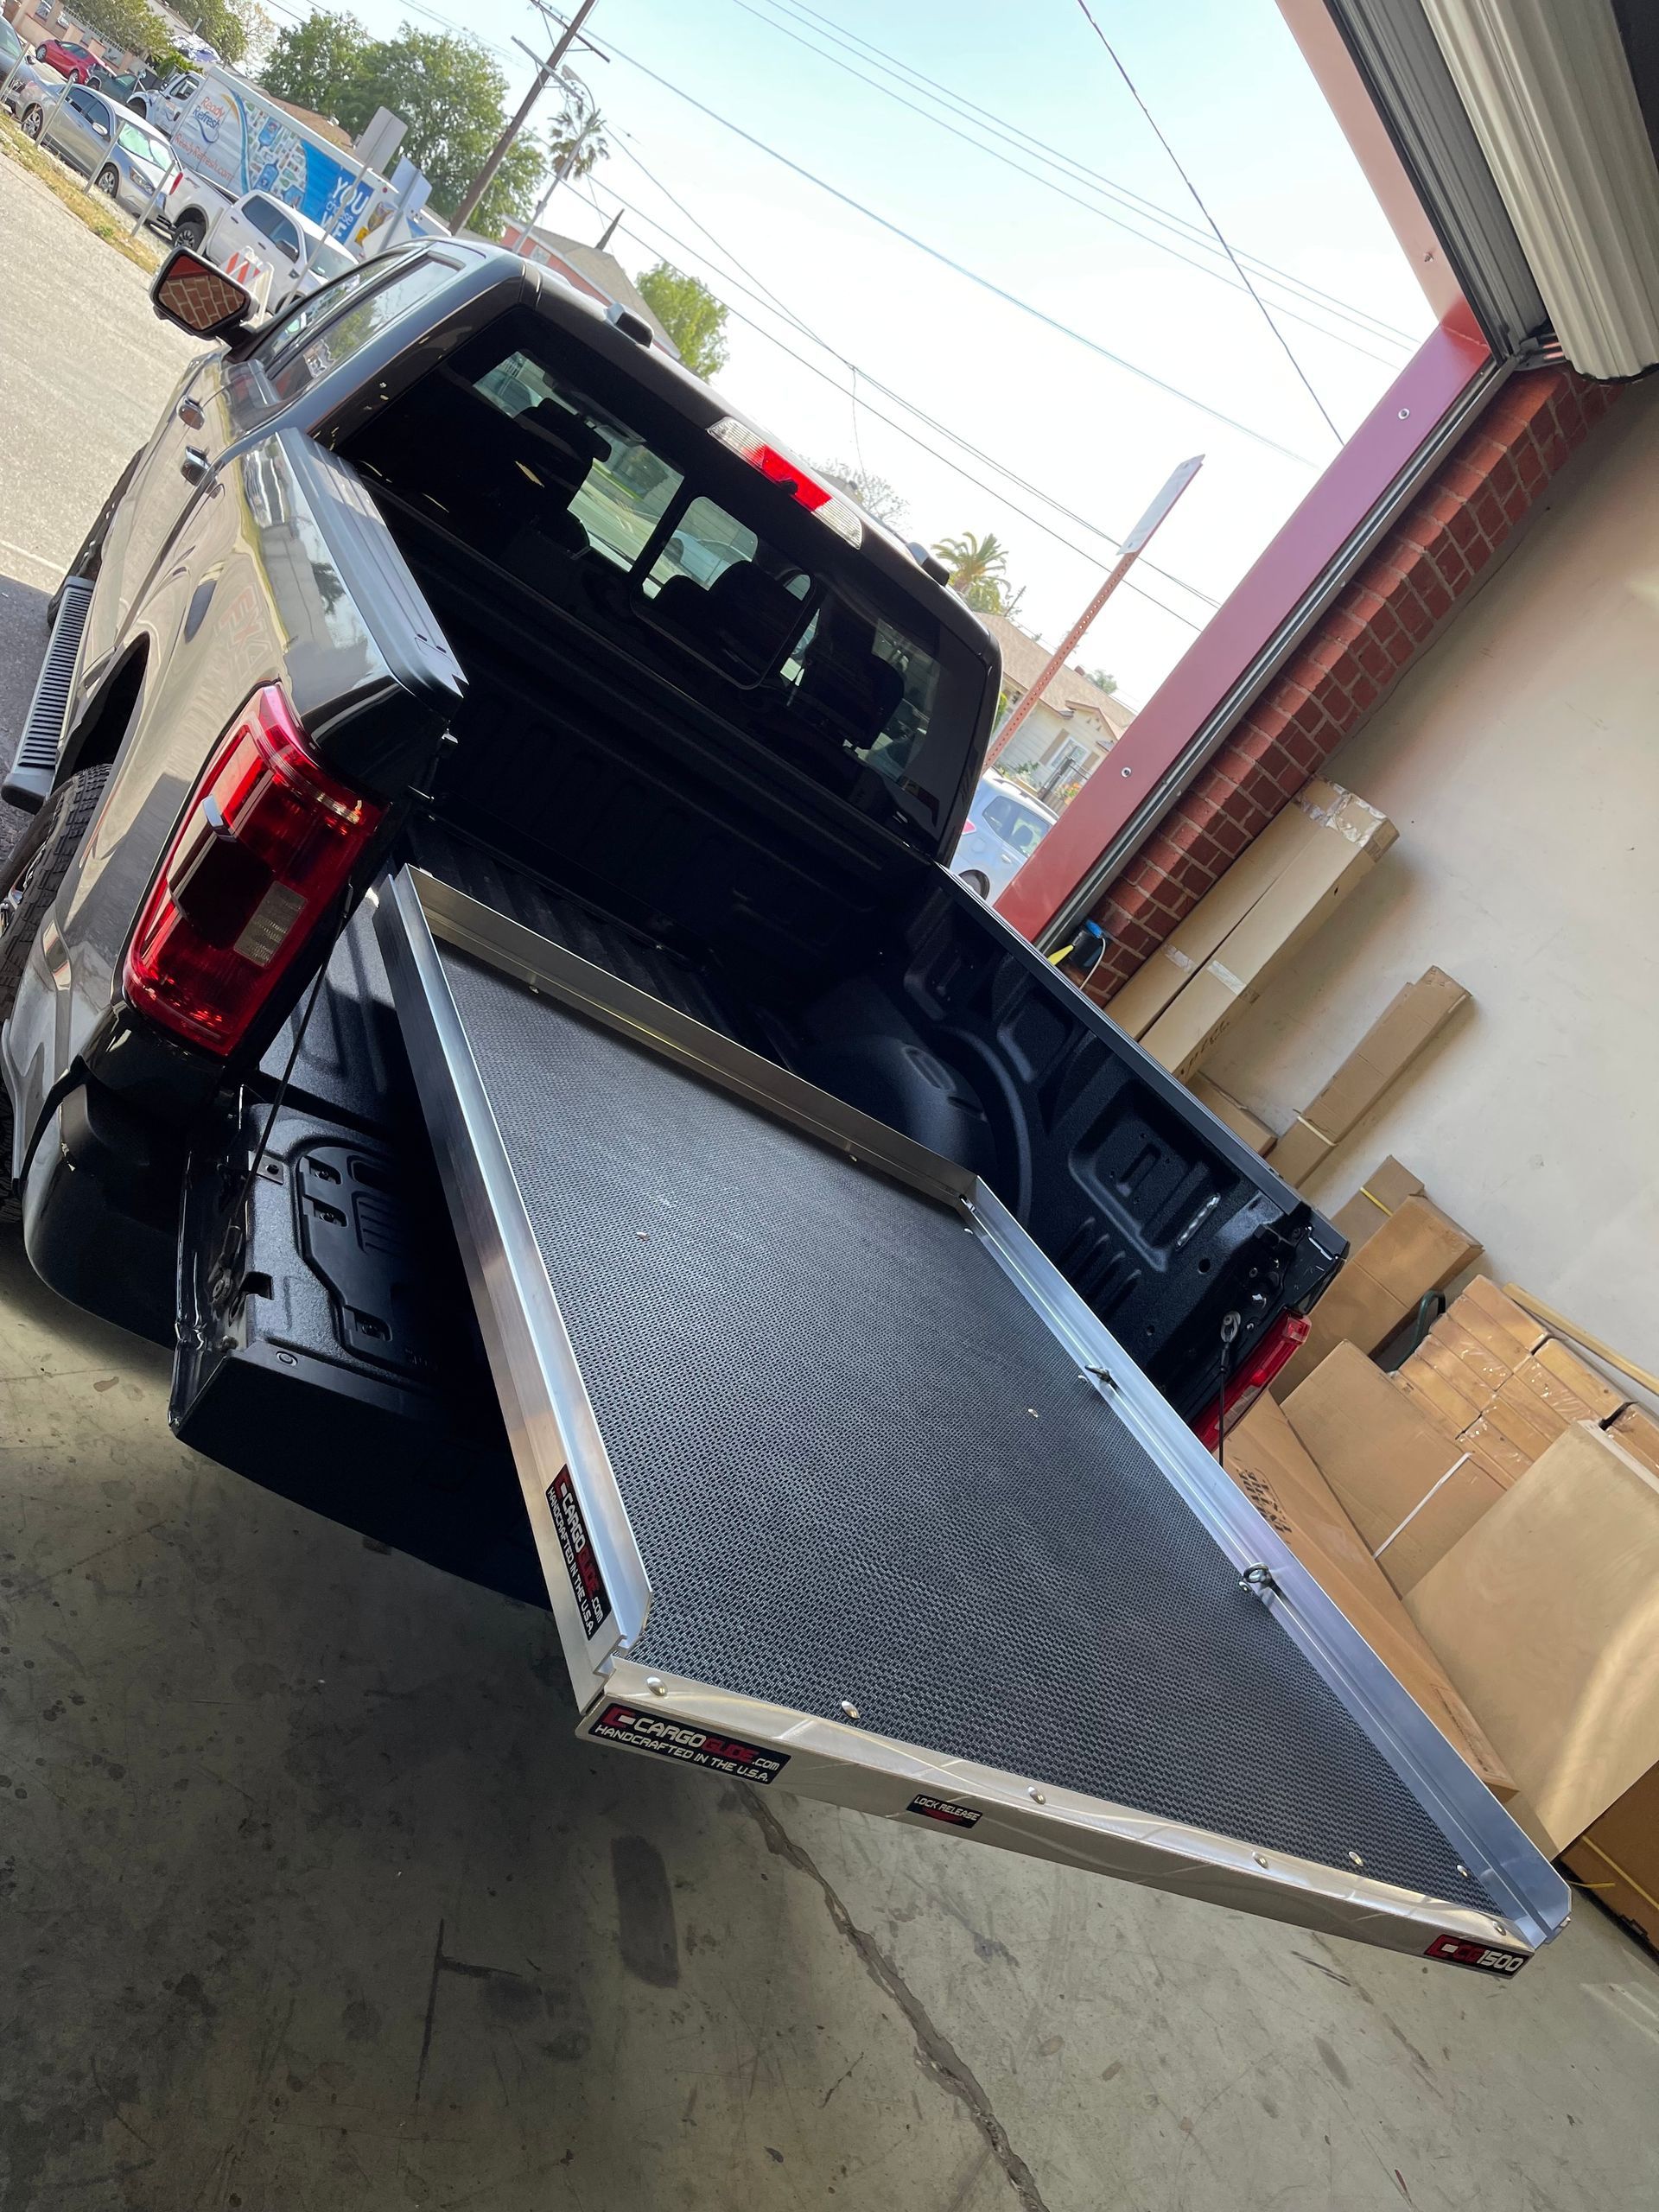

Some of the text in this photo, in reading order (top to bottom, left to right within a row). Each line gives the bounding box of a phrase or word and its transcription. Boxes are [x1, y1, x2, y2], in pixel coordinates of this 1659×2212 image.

[193, 105, 221, 130] Refresh
[201, 97, 225, 118] Ready
[333, 176, 369, 214] YOU
[547, 1486, 575, 1565] HANDCRAFTED
[569, 1562, 577, 1577] IN
[573, 1573, 585, 1602] THE
[594, 1724, 769, 1782] HANDCRAFTED IN THE U.S.A.
[913, 1796, 981, 1821] LOCK RELEASE
